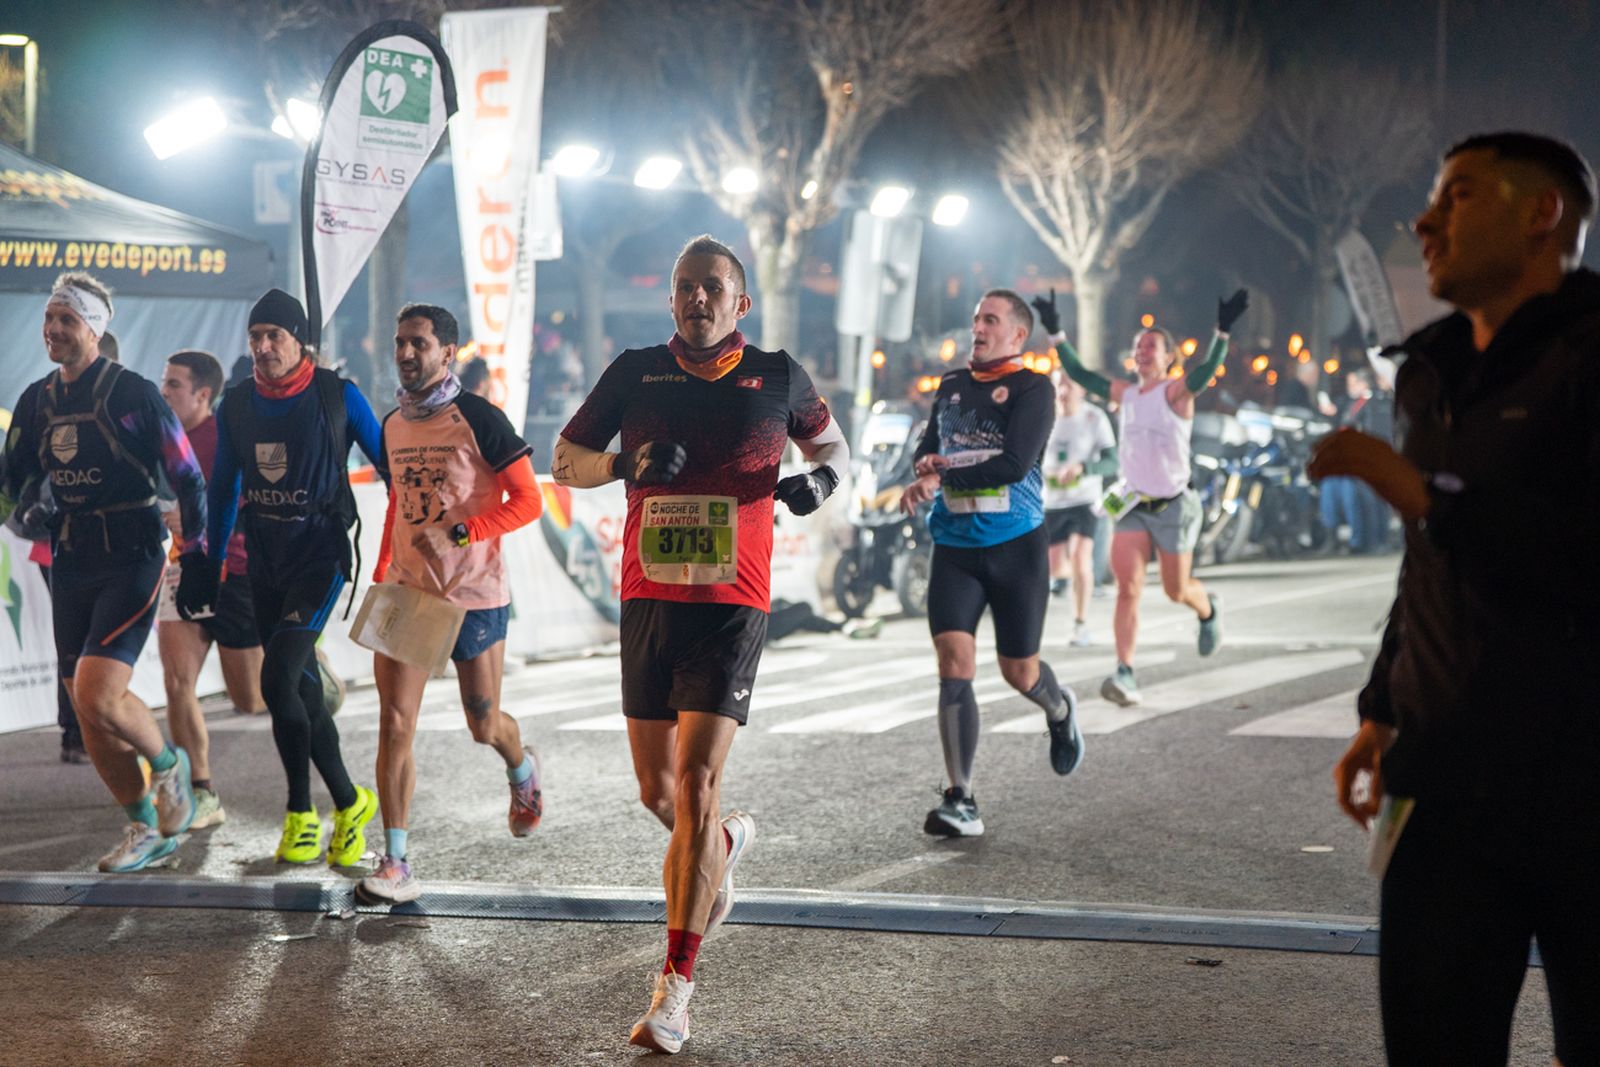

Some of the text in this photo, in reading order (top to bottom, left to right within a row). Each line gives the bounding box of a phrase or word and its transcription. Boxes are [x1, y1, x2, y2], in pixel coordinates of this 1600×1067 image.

[366, 49, 403, 68] DEA
[316, 158, 405, 185] GYSAS
[248, 489, 308, 506] MEDAC
[660, 504, 687, 514] NOCHE
[688, 504, 700, 514] DE
[650, 516, 667, 526] SAN
[658, 527, 714, 554] 3713
